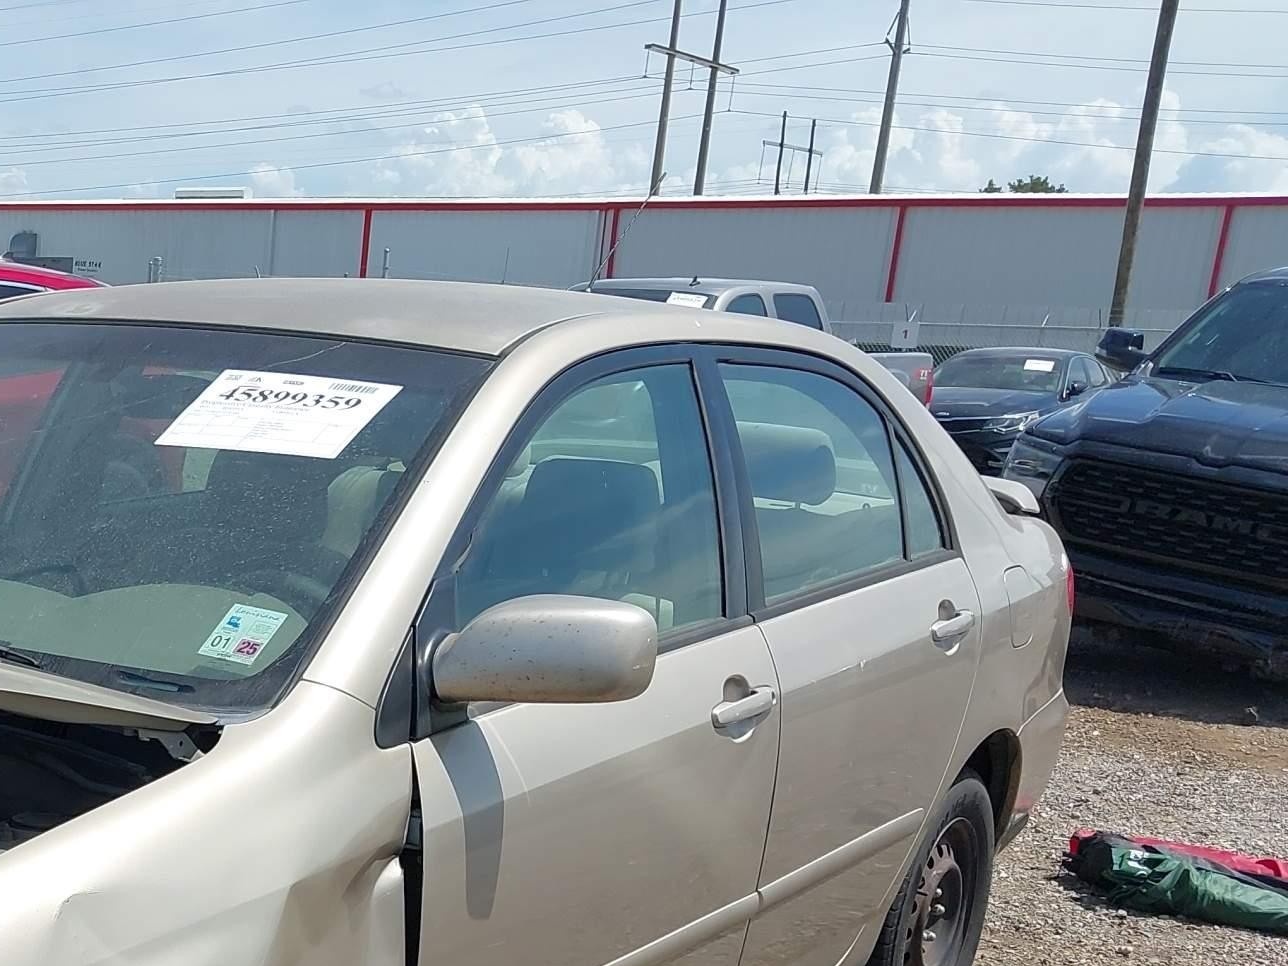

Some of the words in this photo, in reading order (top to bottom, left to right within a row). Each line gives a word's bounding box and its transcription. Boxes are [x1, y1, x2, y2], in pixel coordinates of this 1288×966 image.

[219, 386, 362, 411] 45899359
[210, 635, 232, 649] 01
[236, 640, 261, 656] 25
